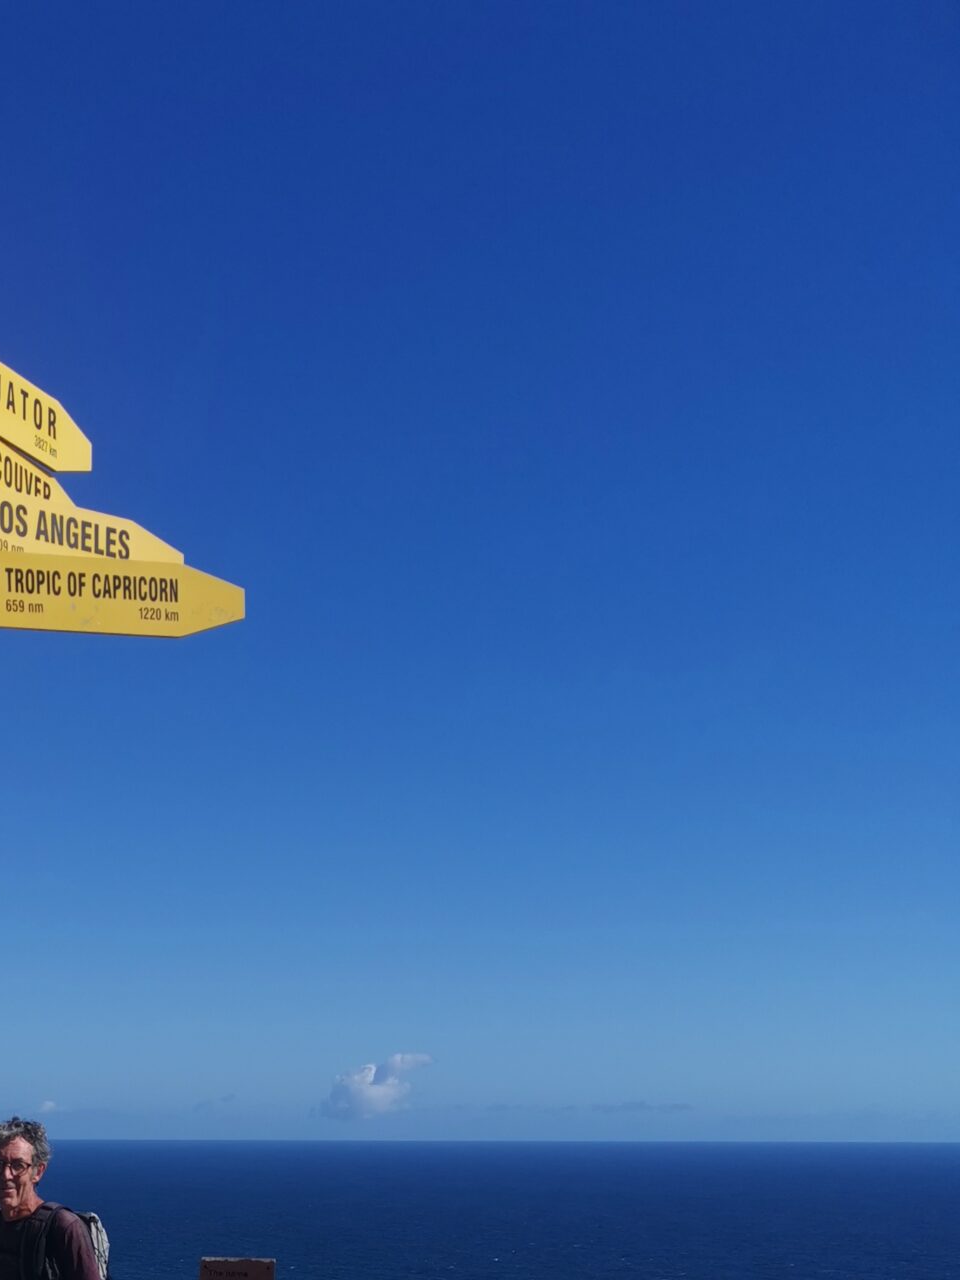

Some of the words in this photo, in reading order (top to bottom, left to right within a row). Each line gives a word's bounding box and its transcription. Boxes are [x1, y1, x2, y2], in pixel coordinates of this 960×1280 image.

[36, 510, 130, 560] ANGELES
[5, 567, 61, 596] TROPIC
[67, 572, 86, 598] OF
[92, 574, 178, 603] CAPRICORN
[6, 600, 25, 612] 659
[28, 602, 44, 614] nm
[138, 608, 162, 621] 1220
[164, 608, 179, 622] km
